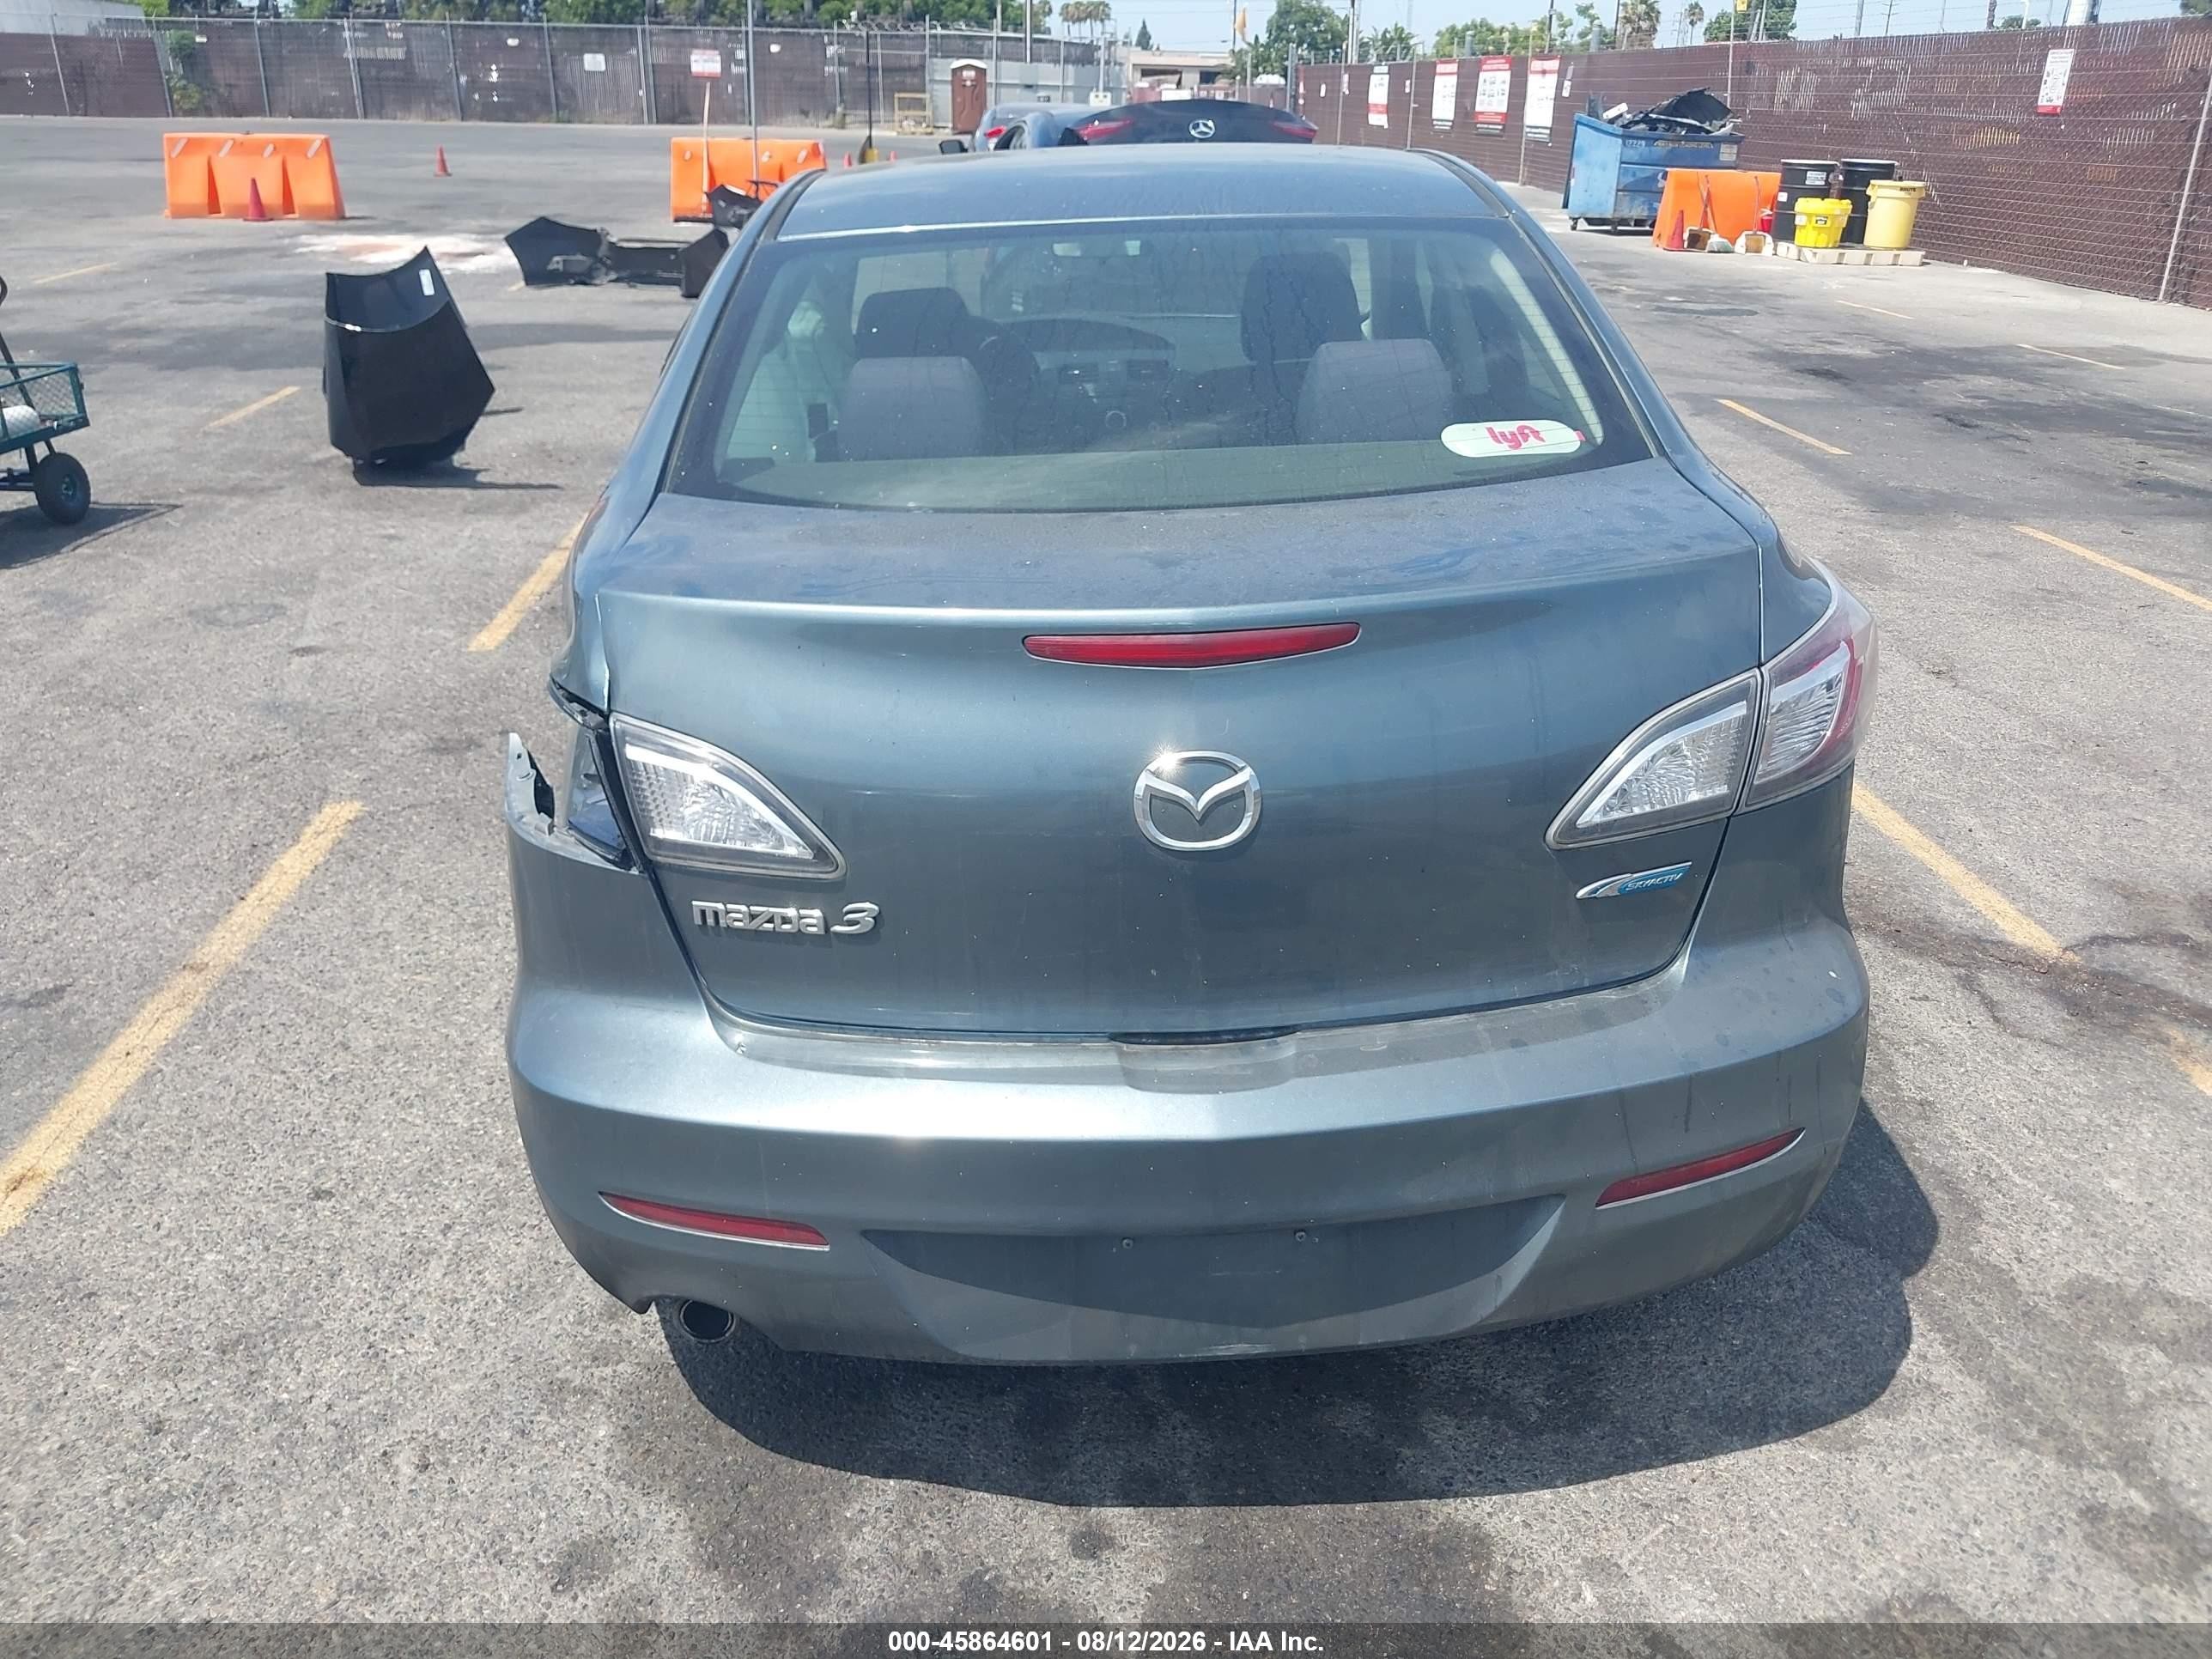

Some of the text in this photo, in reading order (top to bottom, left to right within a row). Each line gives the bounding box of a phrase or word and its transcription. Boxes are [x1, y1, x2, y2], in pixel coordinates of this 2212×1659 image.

[1486, 424, 1546, 450] lyft
[1626, 872, 1683, 891] SKYACTIV
[830, 902, 880, 934] 3
